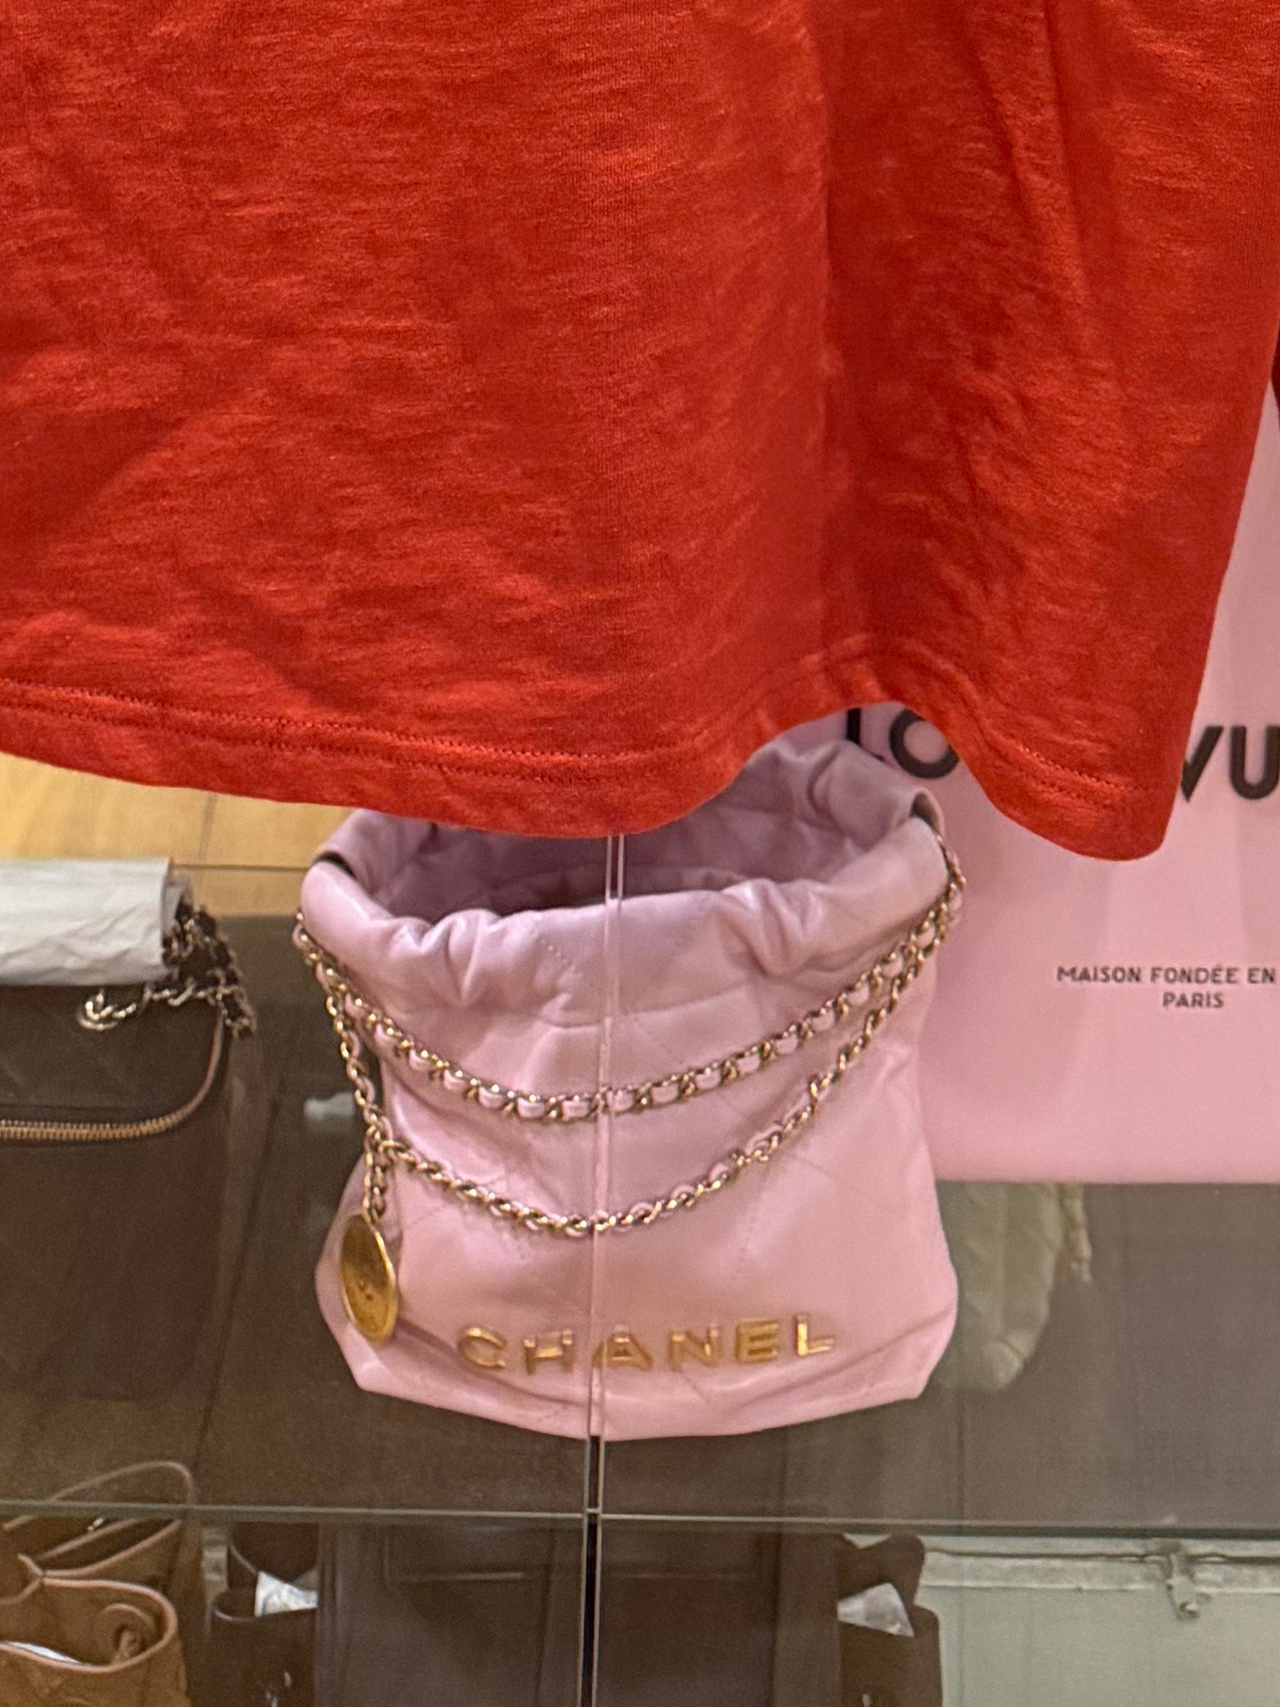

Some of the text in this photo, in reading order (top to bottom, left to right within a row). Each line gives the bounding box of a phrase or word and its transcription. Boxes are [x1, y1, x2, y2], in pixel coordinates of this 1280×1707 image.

[1056, 965, 1141, 983] MAISON
[1150, 963, 1240, 984] FONDÉE
[1247, 966, 1276, 984] EN
[1162, 991, 1225, 1008] PARIS
[457, 1312, 839, 1375] CHANEL
